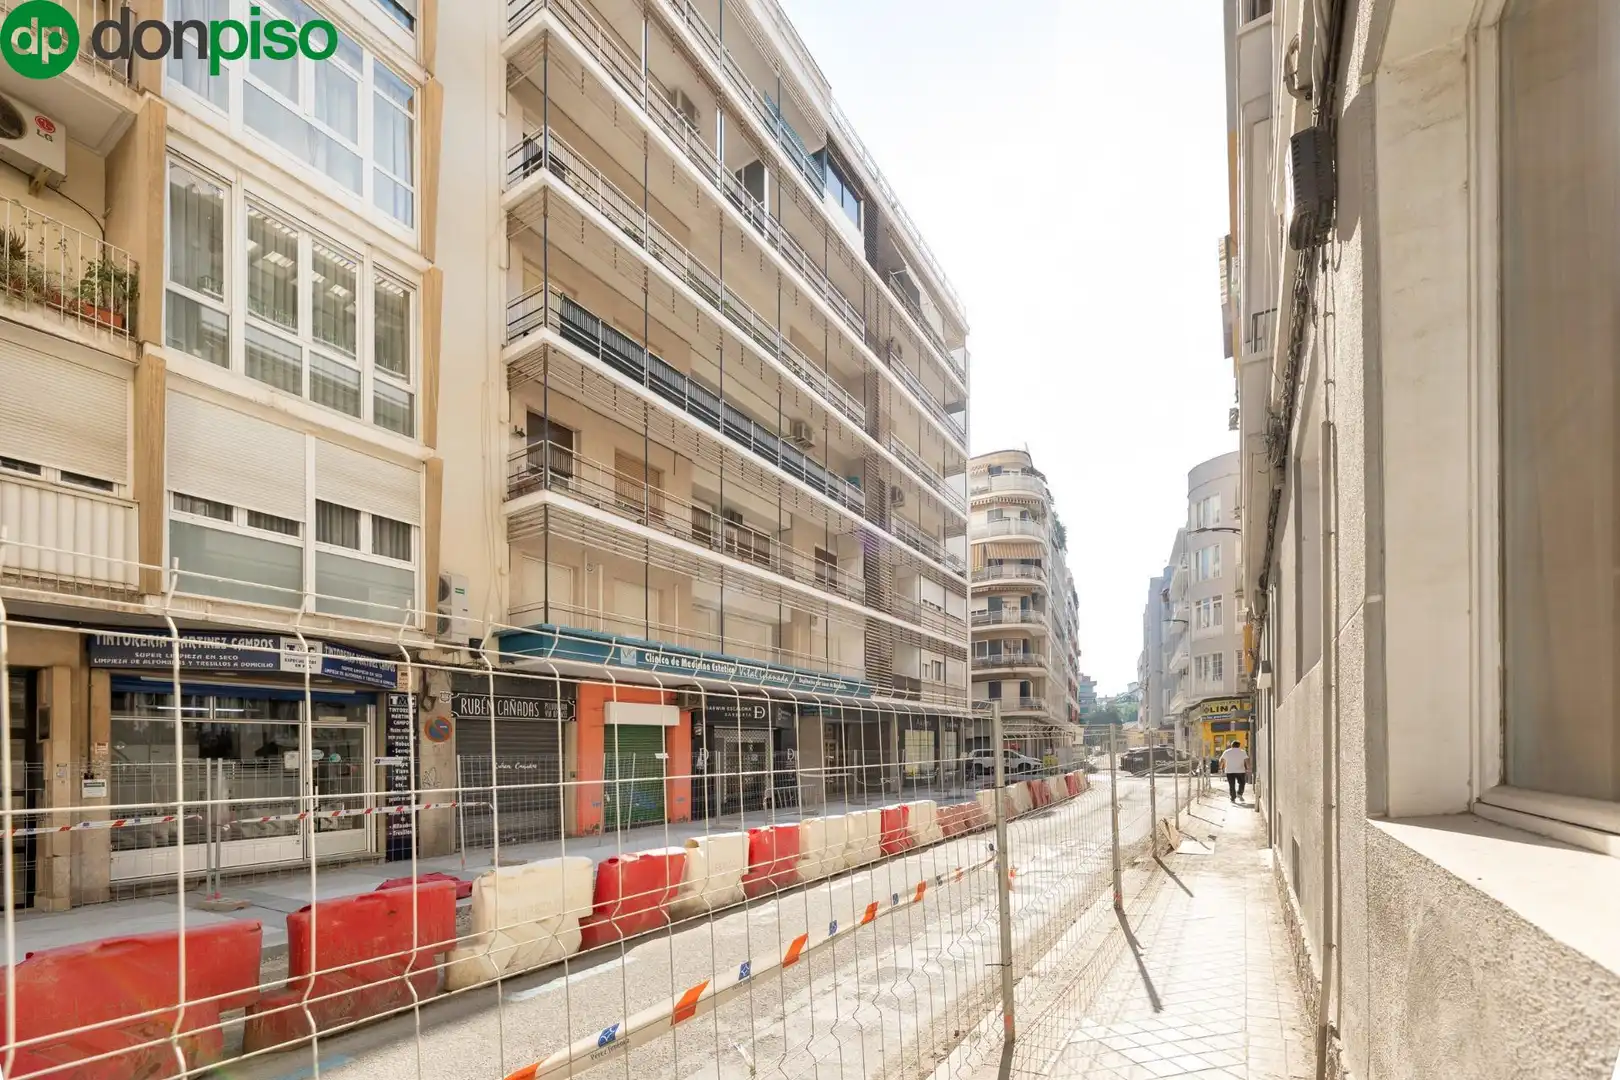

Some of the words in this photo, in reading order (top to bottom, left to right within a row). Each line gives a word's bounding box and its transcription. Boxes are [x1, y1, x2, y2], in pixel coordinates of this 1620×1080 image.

[36, 129, 53, 142] LG
[171, 635, 228, 650] ARTINEZ
[231, 637, 274, 651] CAMPOS
[165, 652, 202, 660] LIPIEZA
[461, 697, 493, 715] RUBÉN
[497, 699, 540, 717] CAÑADAS
